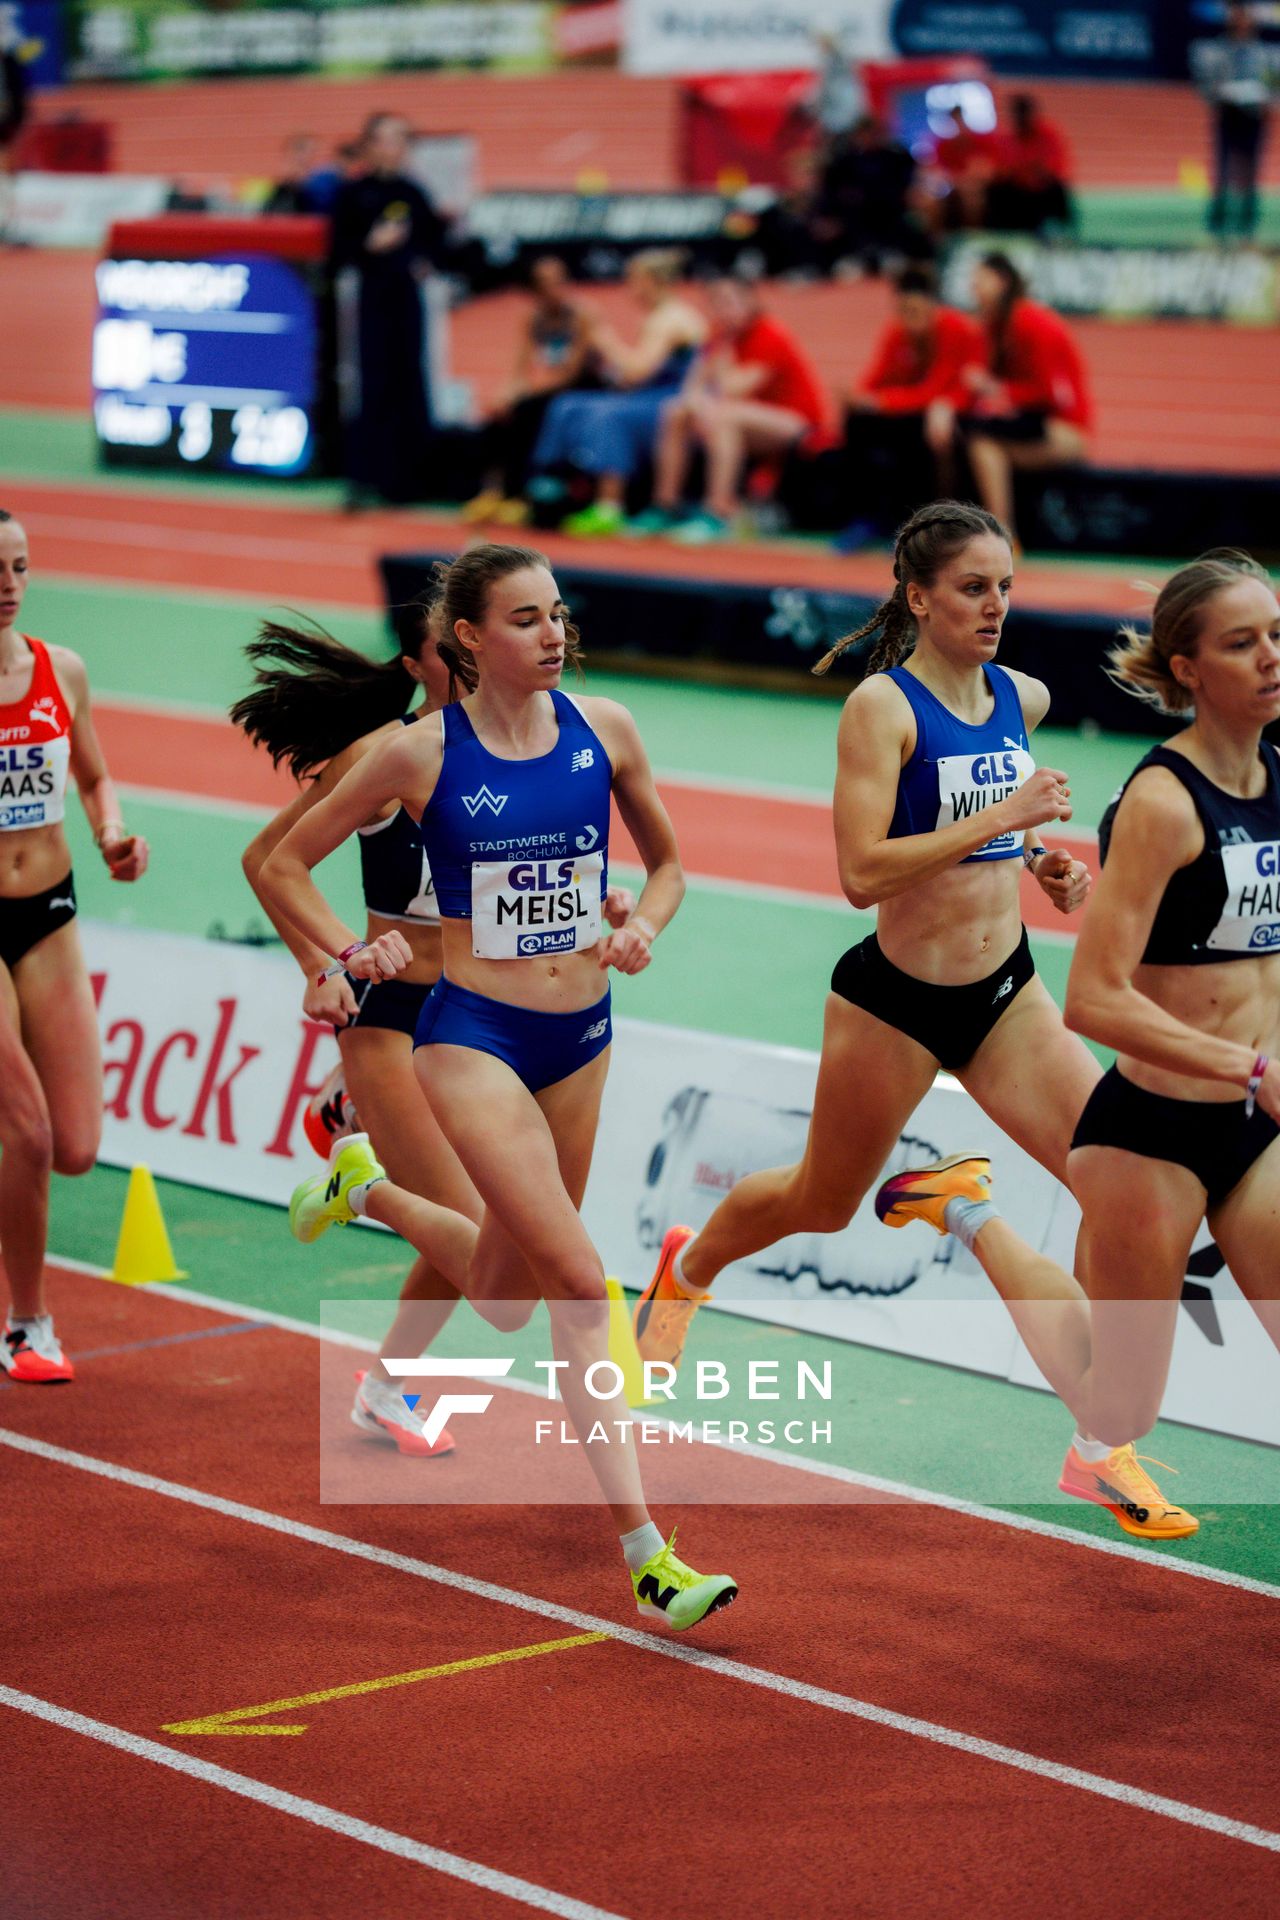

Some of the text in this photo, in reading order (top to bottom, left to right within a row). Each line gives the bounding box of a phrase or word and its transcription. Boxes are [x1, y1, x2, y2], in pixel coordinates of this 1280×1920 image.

[469, 832, 566, 852] STADTWERKE
[507, 845, 567, 861] BOCHUM
[497, 889, 587, 925] MEISL
[543, 932, 574, 946] PLAN
[89, 972, 260, 1145] ack
